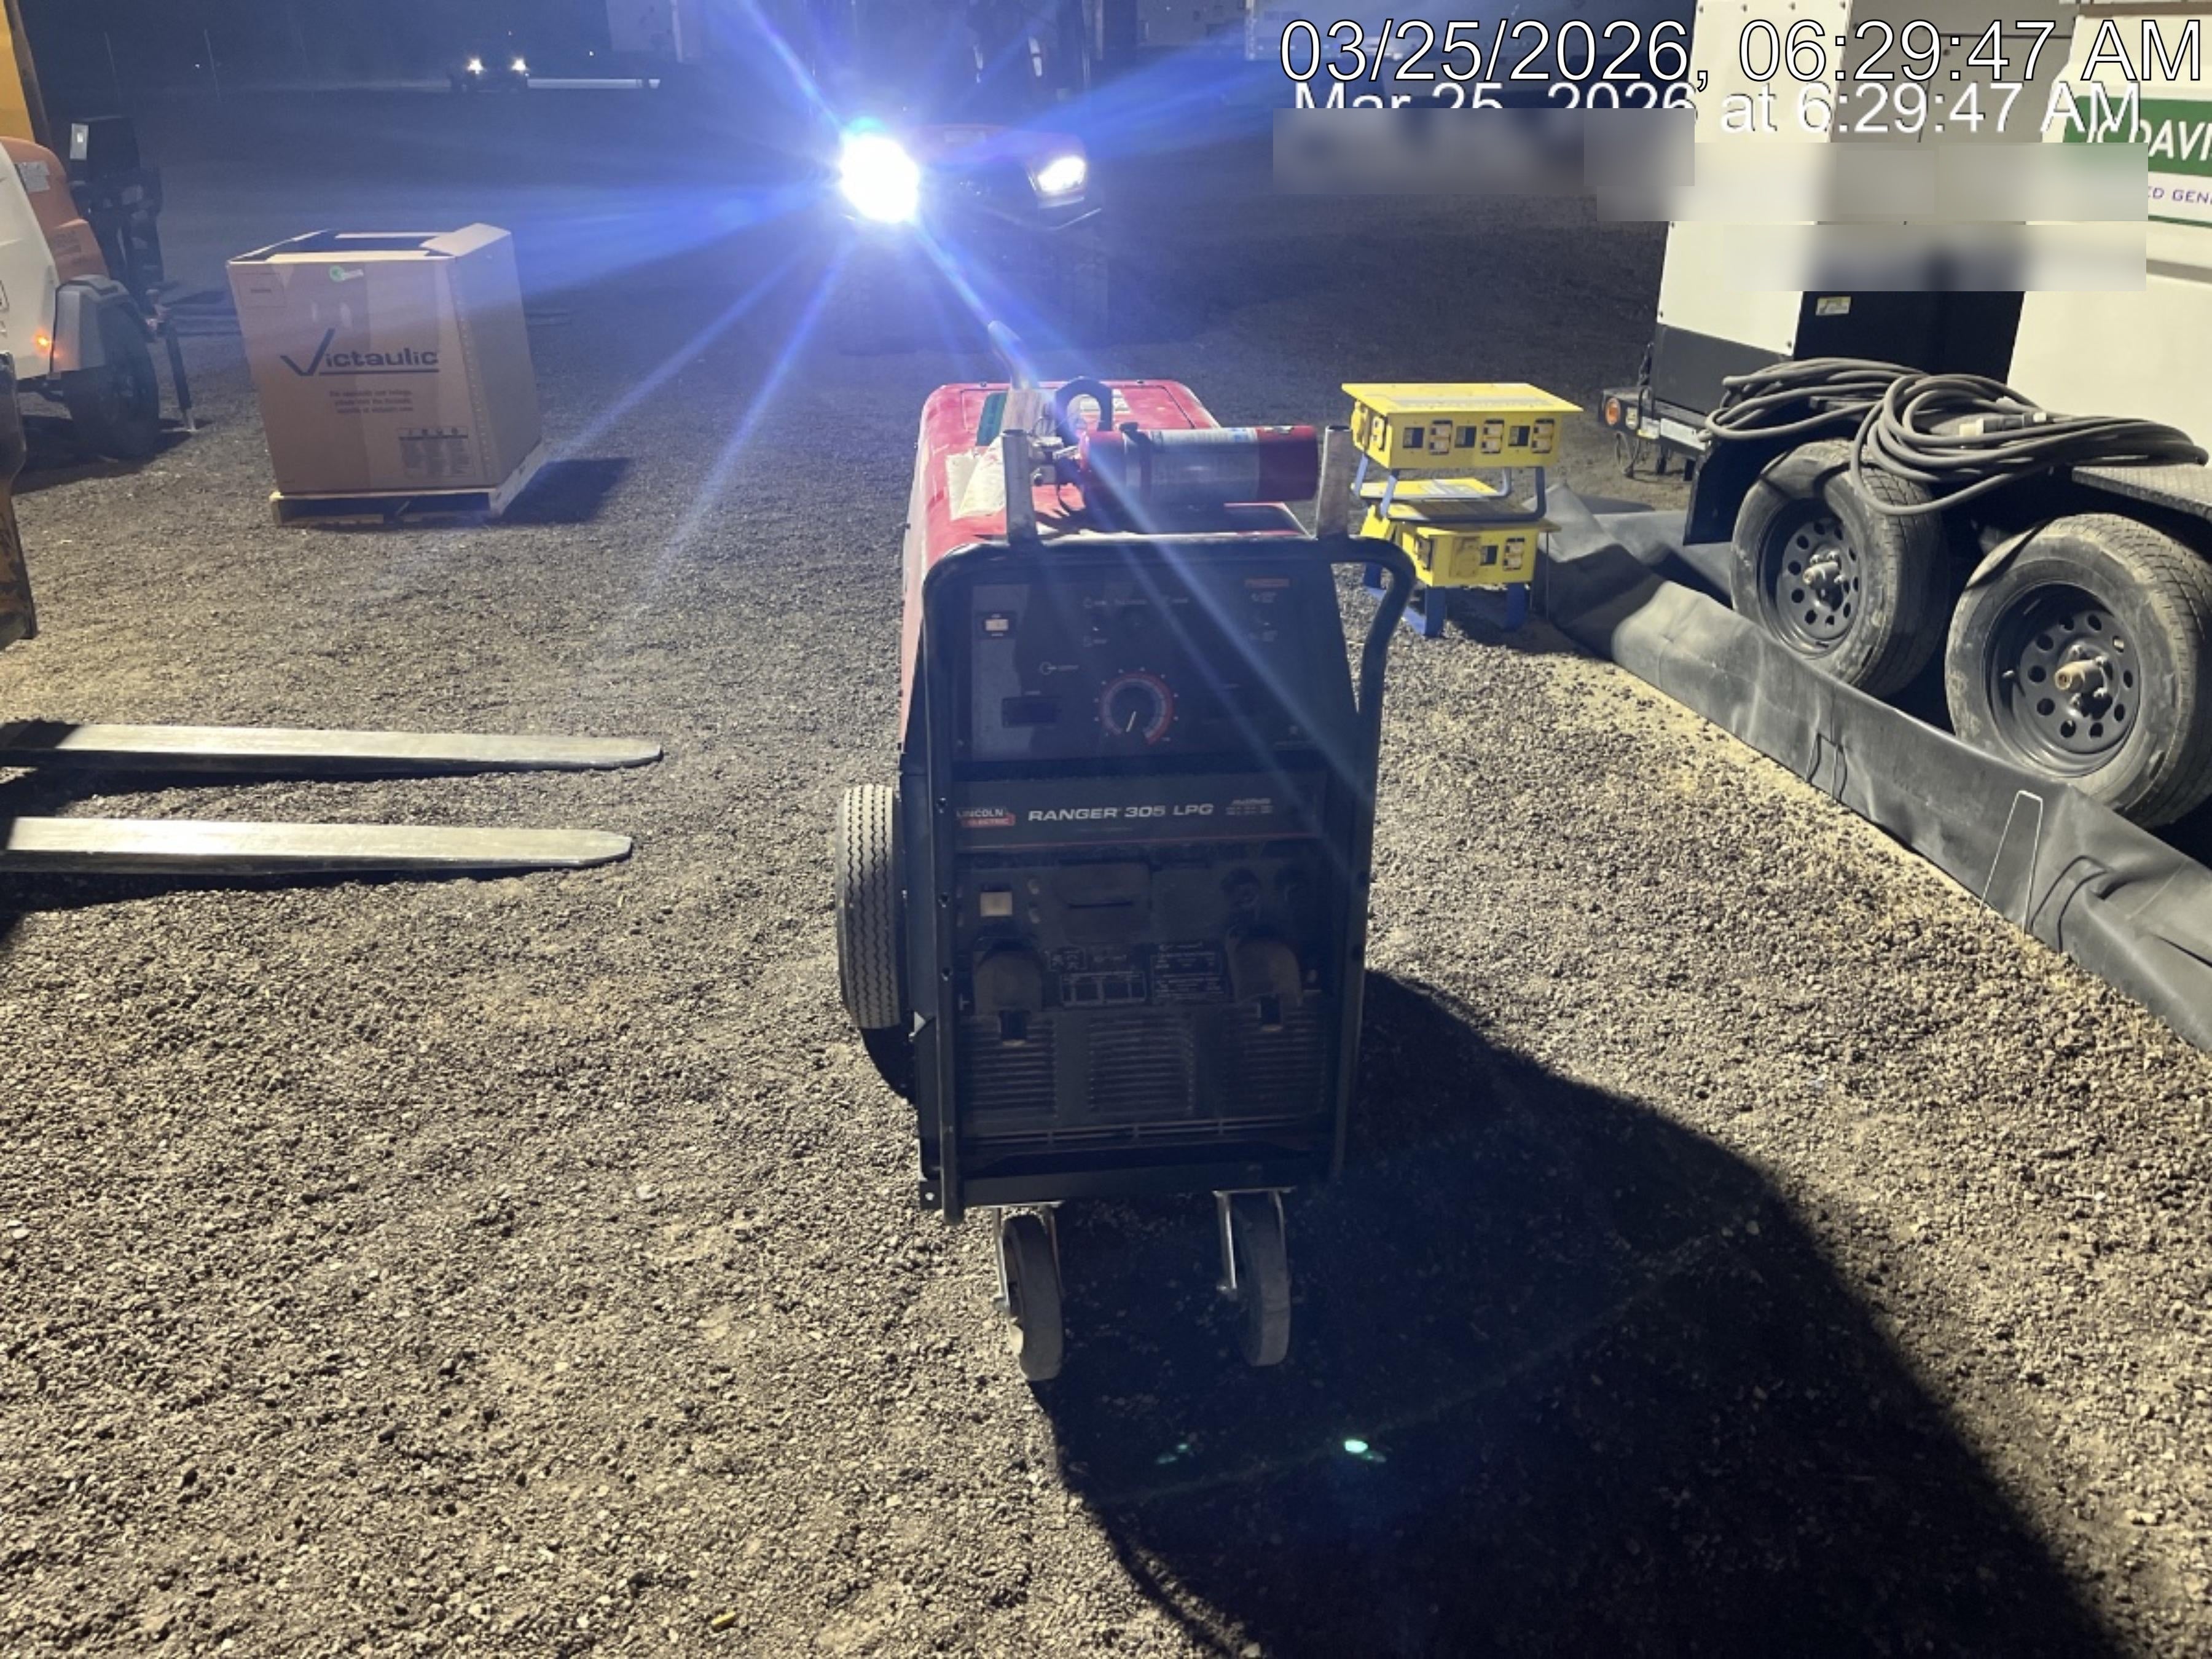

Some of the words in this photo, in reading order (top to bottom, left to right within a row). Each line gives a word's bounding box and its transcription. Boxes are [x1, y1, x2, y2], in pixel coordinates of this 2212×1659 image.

[2128, 119, 2212, 161] DAVI
[280, 328, 439, 376] Victaulic
[1028, 807, 1118, 822] RANGER
[1124, 806, 1166, 818] 305
[1172, 803, 1214, 816] LPG
